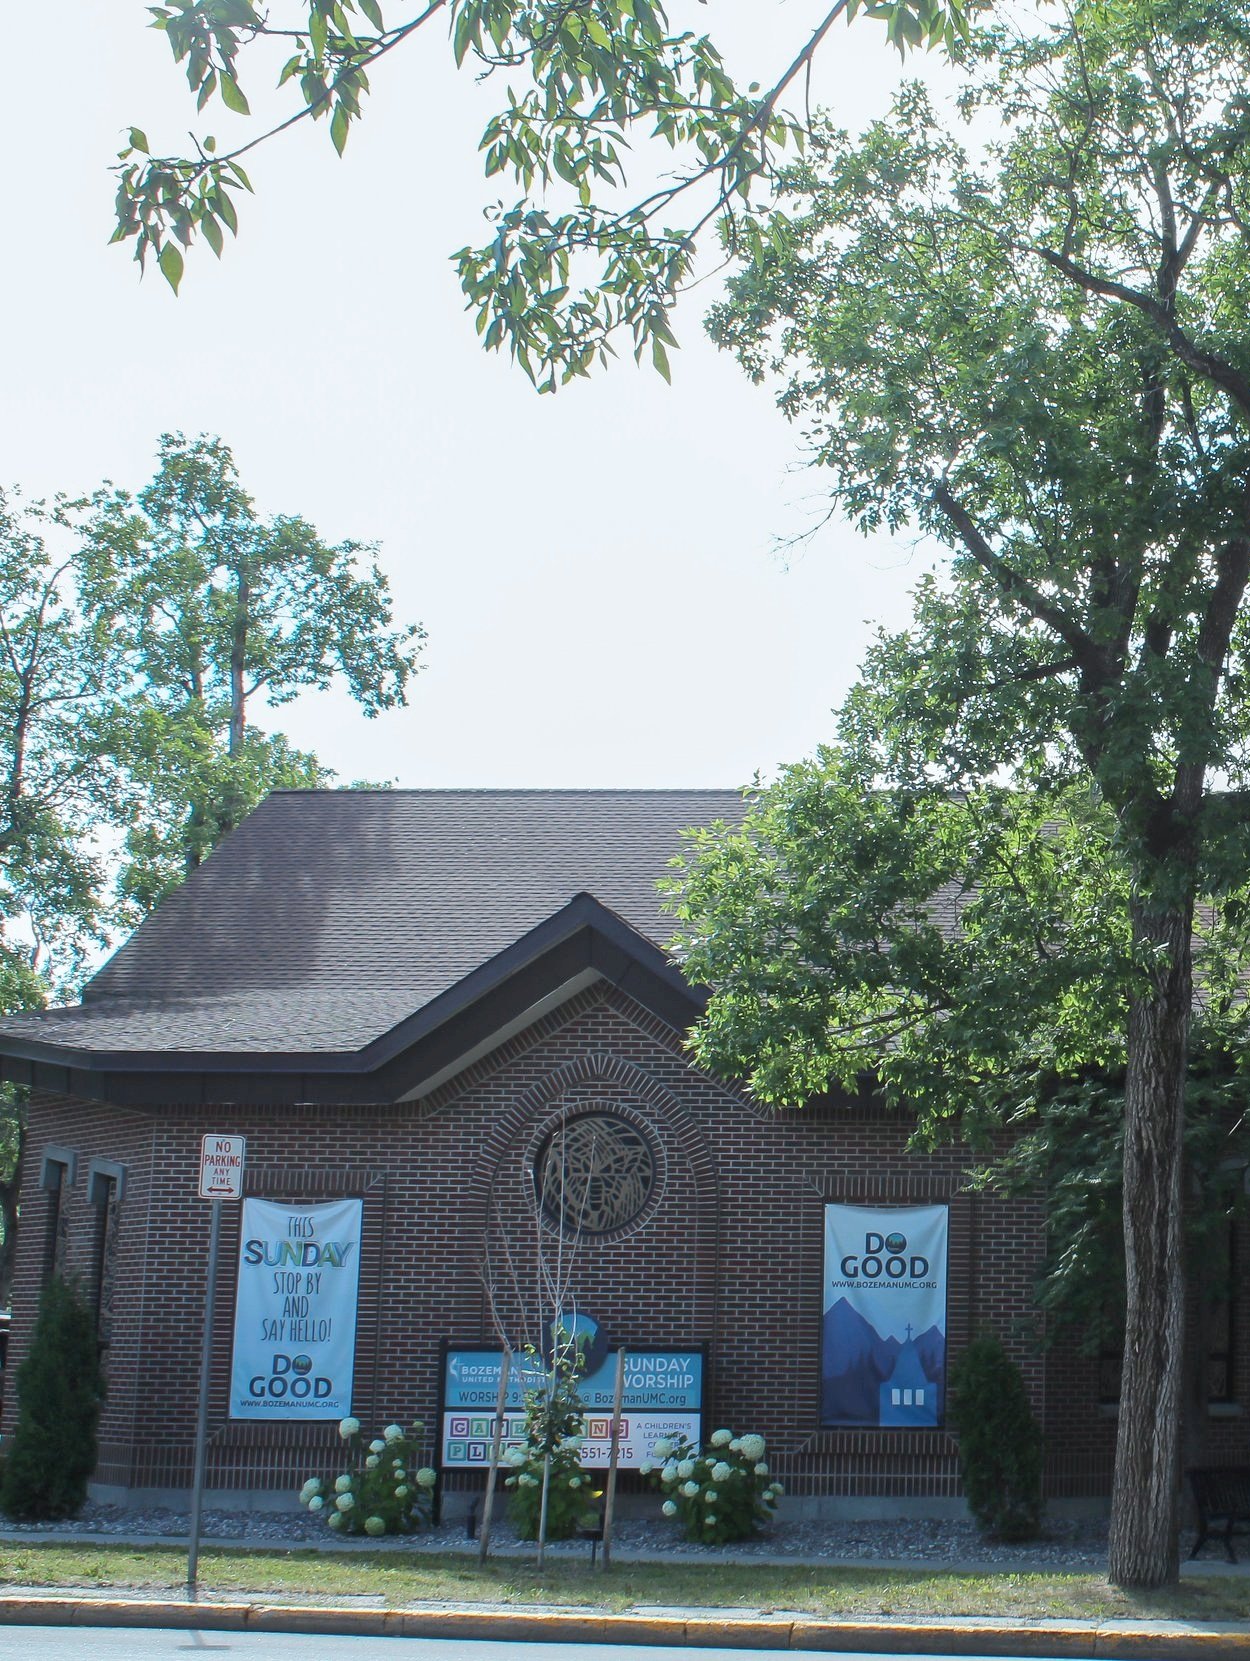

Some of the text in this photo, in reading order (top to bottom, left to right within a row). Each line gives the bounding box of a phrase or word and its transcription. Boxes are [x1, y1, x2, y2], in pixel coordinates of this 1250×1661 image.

[216, 1141, 232, 1153] NO
[204, 1154, 241, 1167] PARKING
[213, 1168, 231, 1176] ANY
[211, 1176, 232, 1186] TIME
[287, 1216, 316, 1238] THIS
[865, 1231, 907, 1255] DO
[244, 1239, 356, 1268] SUNDAY
[840, 1255, 930, 1279] GOOD
[273, 1271, 322, 1295] STOP BY
[831, 1280, 938, 1289] WWW.BOZEMANUMC.ORG
[282, 1295, 309, 1319] AND
[260, 1317, 333, 1343] SAY HELLO!
[271, 1353, 313, 1376] DO
[461, 1366, 519, 1375] BOZEMN
[623, 1357, 691, 1372] SUNDAY
[248, 1375, 333, 1399] GOOD
[240, 1399, 340, 1408] WWW.BOZEMANUMC.ORG
[458, 1391, 510, 1403] WORSHP
[594, 1392, 687, 1406] BozmanUMC.org
[636, 1422, 692, 1430] A CHILDREN'S
